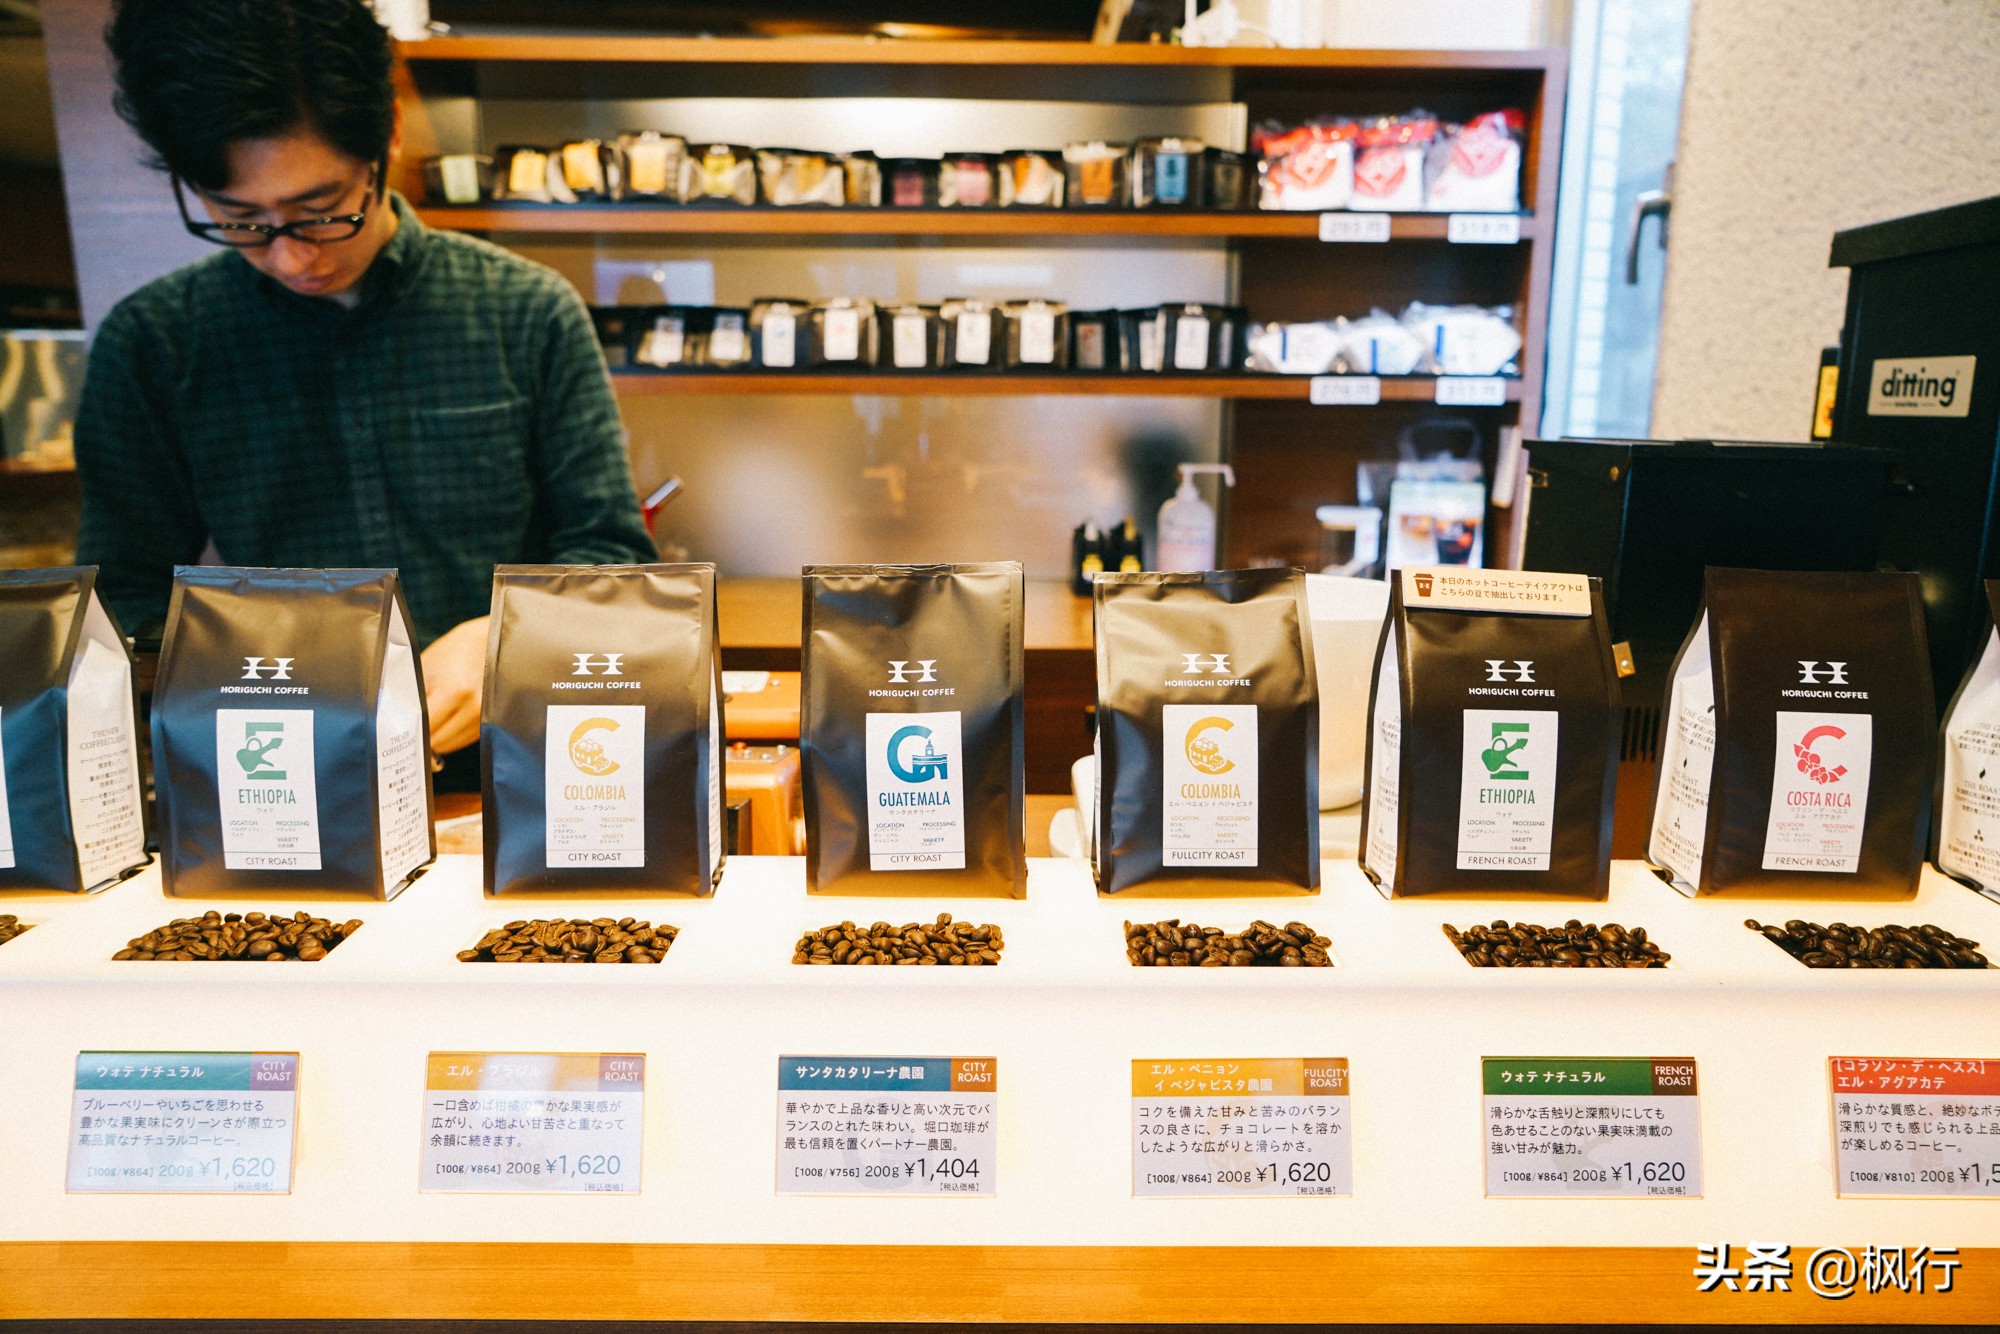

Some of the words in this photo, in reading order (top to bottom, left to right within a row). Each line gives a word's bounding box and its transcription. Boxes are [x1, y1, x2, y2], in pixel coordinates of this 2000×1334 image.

[1882, 367, 1956, 407] ditting
[1440, 577, 1583, 592] 本日のホットコーヒーテイクアウトは
[1441, 588, 1562, 602] こちらの豆で抽出しております。
[552, 681, 604, 689] HORIGUCHI
[607, 681, 641, 689] COFFEE
[1165, 679, 1214, 687] HORIGUCHI
[220, 686, 272, 695] HORIGUCHI
[274, 687, 309, 695] COFFEE
[869, 689, 920, 697] HORIGUCHI
[922, 688, 955, 697] COFFEE
[1468, 687, 1519, 696] HORIGUCHI
[1522, 688, 1555, 697] COFFEE
[1782, 689, 1832, 698] HORIGUCHI
[1835, 691, 1868, 699] COFFEE
[239, 789, 296, 804] ETHIOPIA
[564, 785, 626, 800] COLOMBIA
[1181, 783, 1241, 798] COLOMBIA
[1480, 788, 1535, 804] ETHIOPIA
[879, 791, 950, 807] GUATEMALA
[1787, 791, 1822, 806] COSTA
[1825, 792, 1851, 807] RICA
[245, 857, 265, 865] CITY
[568, 853, 588, 861] CITY
[592, 853, 621, 861] ROAST
[890, 855, 910, 863] CITY
[1172, 851, 1212, 859] FULLCITY
[1215, 851, 1245, 859] ROAST
[1468, 856, 1505, 865] FRENCH
[1508, 857, 1537, 865] ROAST
[1776, 857, 1813, 866] FRENCH
[1816, 859, 1846, 867] ROAST
[97, 1066, 135, 1078] ウォテ
[140, 1066, 205, 1078] ナチュラル
[262, 1061, 287, 1071] CITY
[610, 1061, 634, 1071] CITY
[962, 1062, 987, 1072] CITY
[1304, 1068, 1348, 1077] FULLCITY
[1655, 1066, 1694, 1076] FRENCH
[256, 1072, 292, 1082] ROAST
[605, 1072, 639, 1082] ROAST
[796, 1066, 925, 1080] サンタカタリーナ農園
[958, 1072, 992, 1083] ROAST
[1501, 1072, 1538, 1083] ウォテ
[1543, 1071, 1606, 1083] ナチュラル
[1311, 1078, 1343, 1087] ROAST
[1658, 1076, 1692, 1086] ROAST
[1838, 1077, 1946, 1089] エル・アグアカテ
[83, 1099, 264, 1111] ブルーベリーやいちごを思わせる
[433, 1099, 621, 1112] 一口含めば柑橘のかな果実感が
[785, 1102, 991, 1116] 華やかで上品な香りと高い次元でバ
[1139, 1106, 1341, 1118] コクを備えた甘みと苦みのバラン
[1490, 1107, 1665, 1120] 滑らかな舌触りと深煎りにしても
[80, 1116, 287, 1129] 豊かな果実味にクリーンさが際立つ
[431, 1116, 625, 1130] 広がり、心地よい甘苦さと重なって
[785, 1120, 989, 1133] ランスのとれた味わい。堀口珈琲が
[1840, 1120, 2000, 1135] 深煎りでも感じられる上品
[1139, 1123, 1342, 1136] スの良さに、チョコレートを溶か
[1491, 1125, 1673, 1138] 色あせることのない果実味満載の
[79, 1134, 241, 1147] 高品質なナチュラルコーヒー。
[430, 1134, 522, 1147] 余韻に続きます。
[784, 1137, 959, 1152] 最も信頼を置くパートナー農園。
[1140, 1140, 1313, 1153] したような広がりと滑らかさ。
[1841, 1139, 1962, 1152] が楽しめるコーヒー。
[1491, 1142, 1583, 1155] 強い甘みが魅力。
[158, 1164, 194, 1178] 200g
[200, 1157, 276, 1180] ¥1,620
[506, 1162, 541, 1175] 200g
[546, 1154, 621, 1178] ¥1,620
[865, 1165, 900, 1178] 200g
[905, 1158, 980, 1181] ¥1,404
[1217, 1170, 1251, 1184] 200g
[1256, 1162, 1331, 1185] ¥1,620
[1573, 1170, 1607, 1182] 200g
[1611, 1162, 1686, 1185] ¥1,620
[1920, 1170, 1956, 1183] 200g
